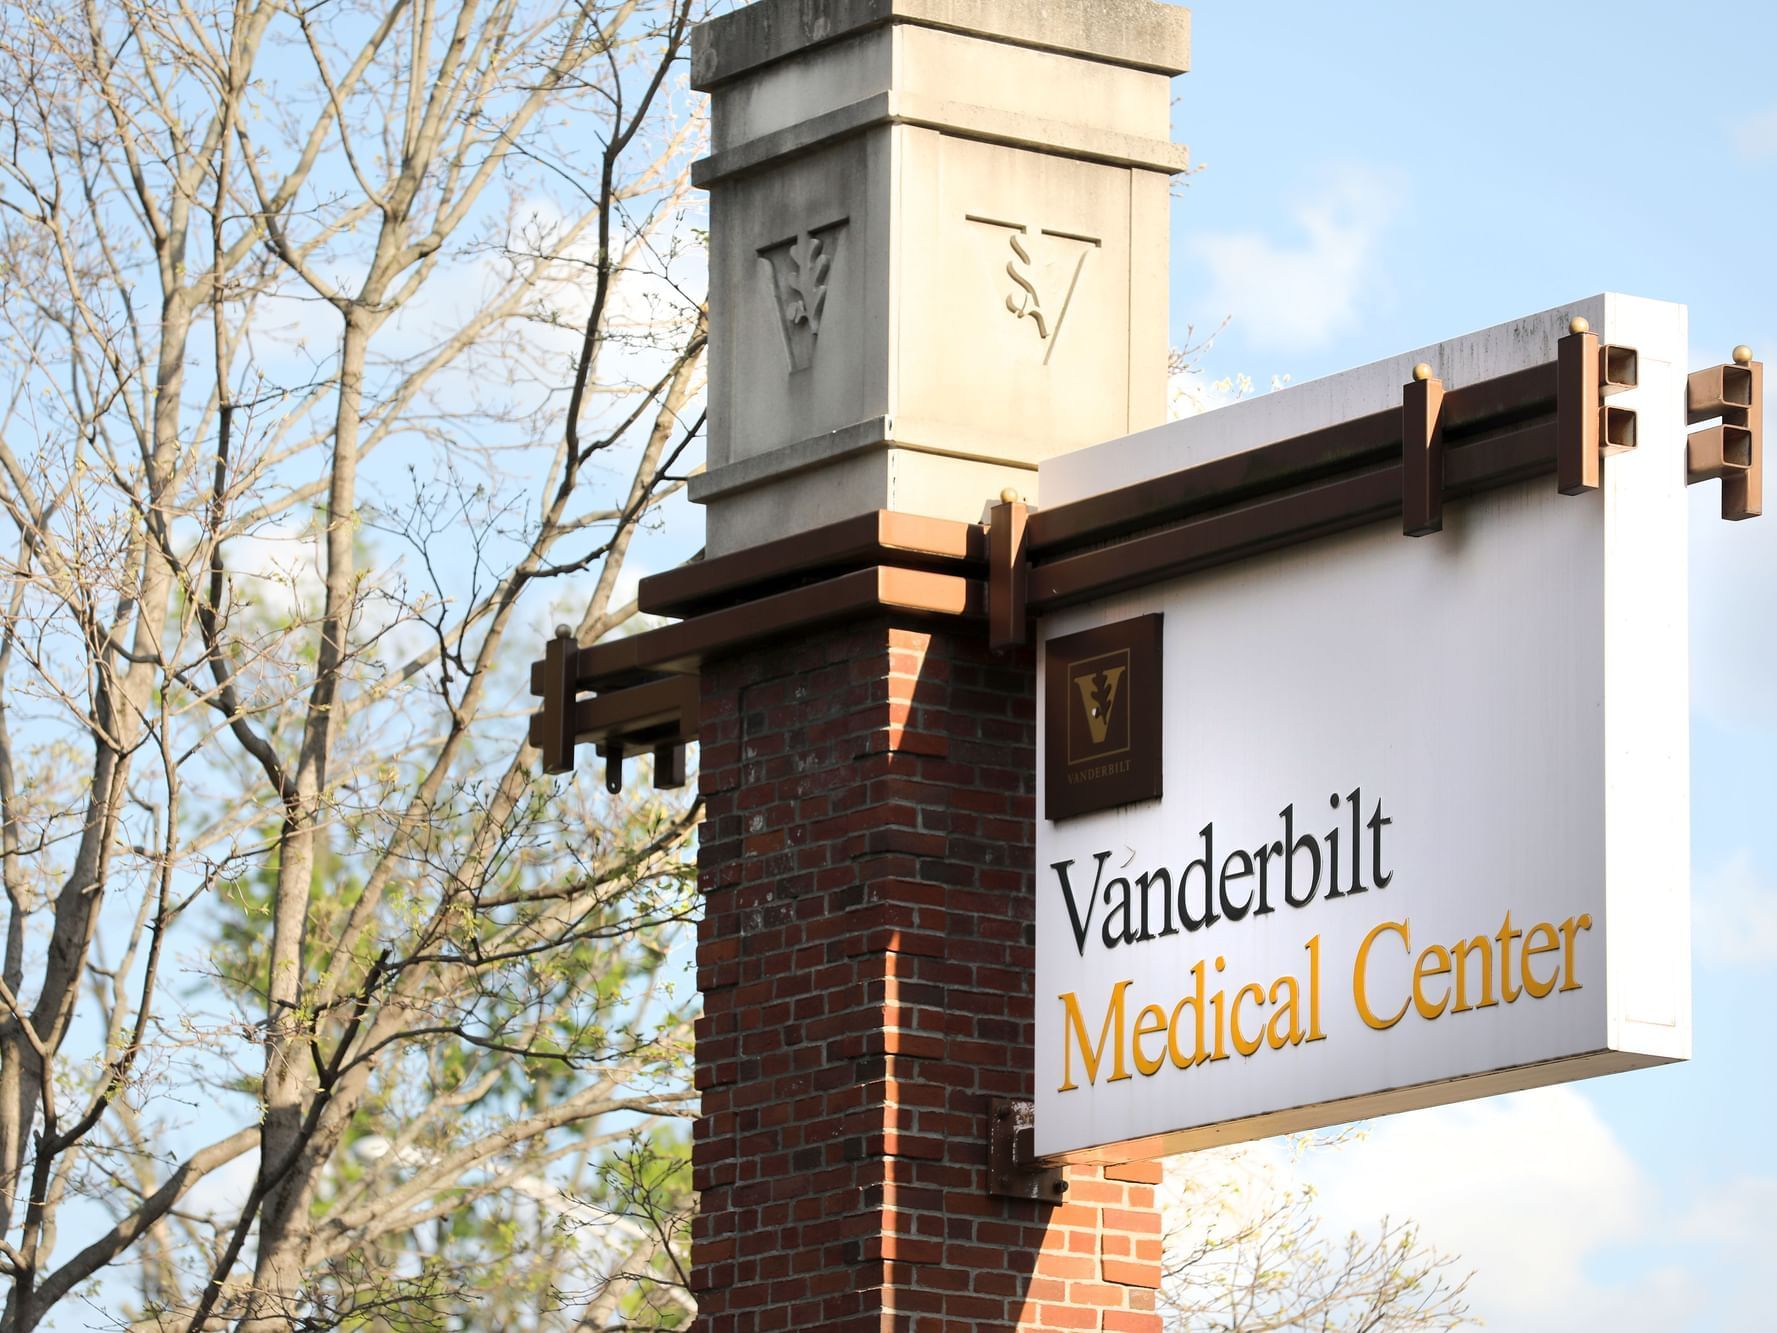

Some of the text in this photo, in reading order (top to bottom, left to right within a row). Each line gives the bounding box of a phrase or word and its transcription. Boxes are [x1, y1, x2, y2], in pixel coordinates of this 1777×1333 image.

[1073, 666, 1126, 744] V
[1067, 759, 1132, 784] VANDERBILT
[1051, 787, 1394, 957] Vanderbilt
[1058, 910, 1593, 1093] Medical Center
